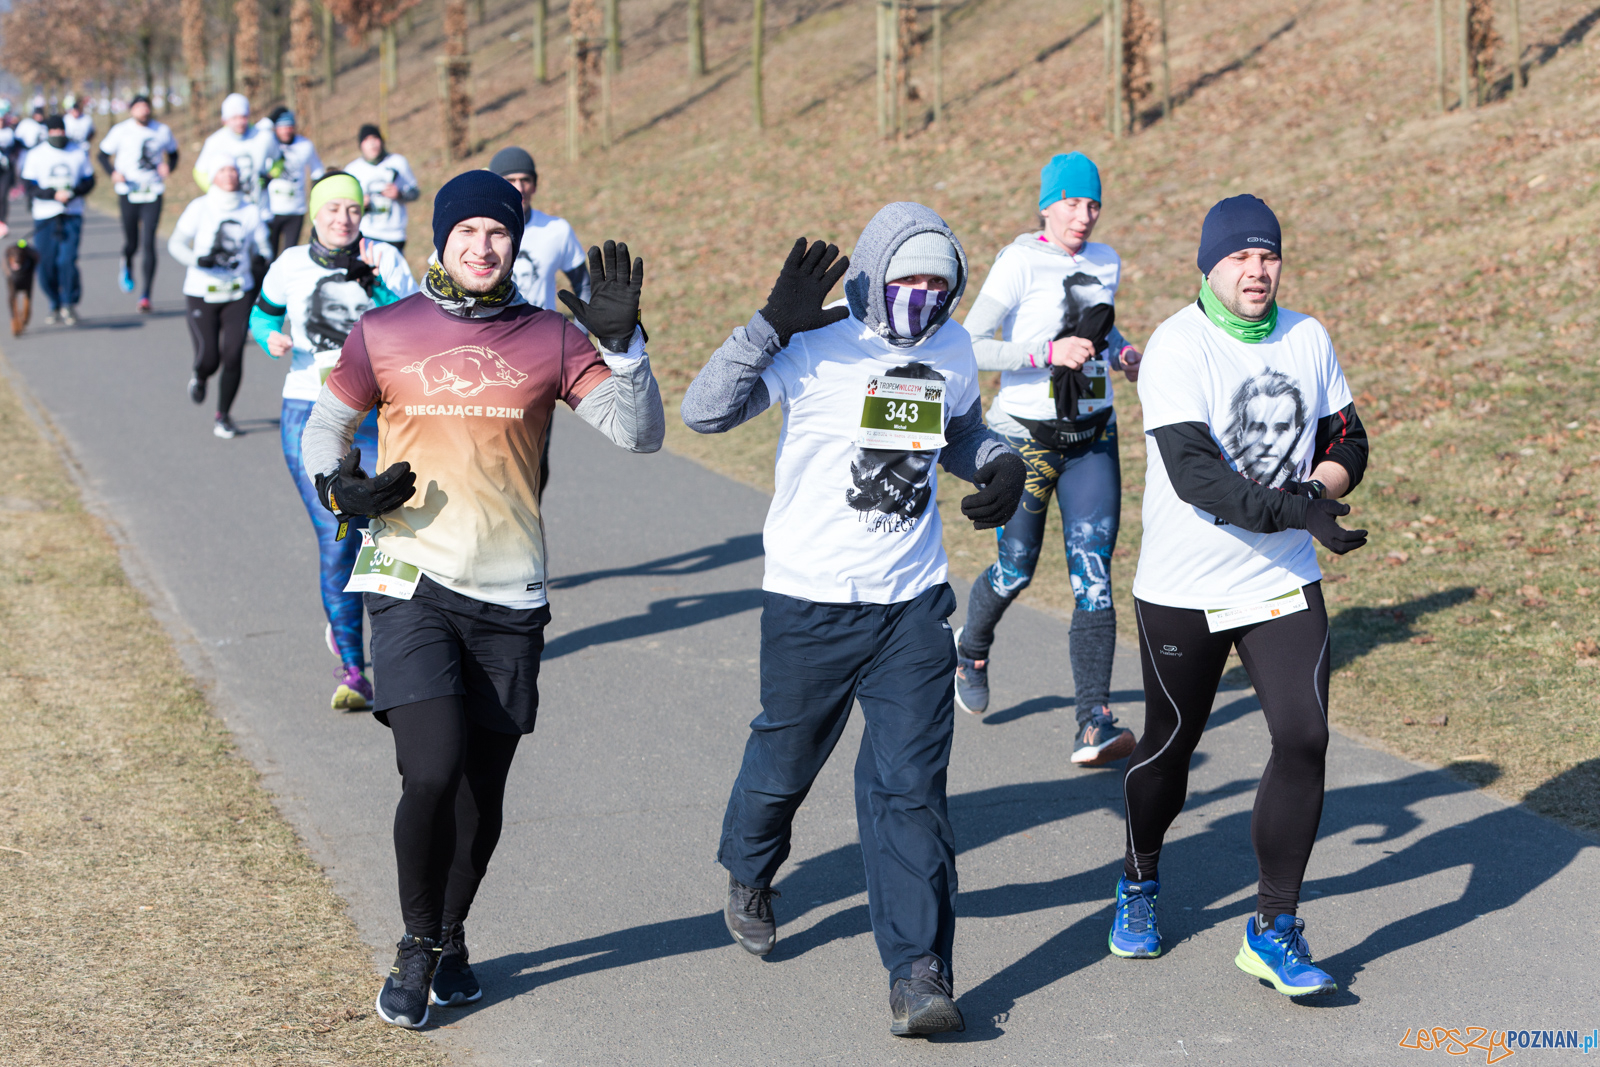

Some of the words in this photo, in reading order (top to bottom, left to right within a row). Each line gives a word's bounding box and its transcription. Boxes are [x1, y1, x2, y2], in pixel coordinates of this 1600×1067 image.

[404, 404, 483, 419] BIEGAJĄCE
[486, 406, 524, 419] DZIKI
[884, 400, 919, 424] 343
